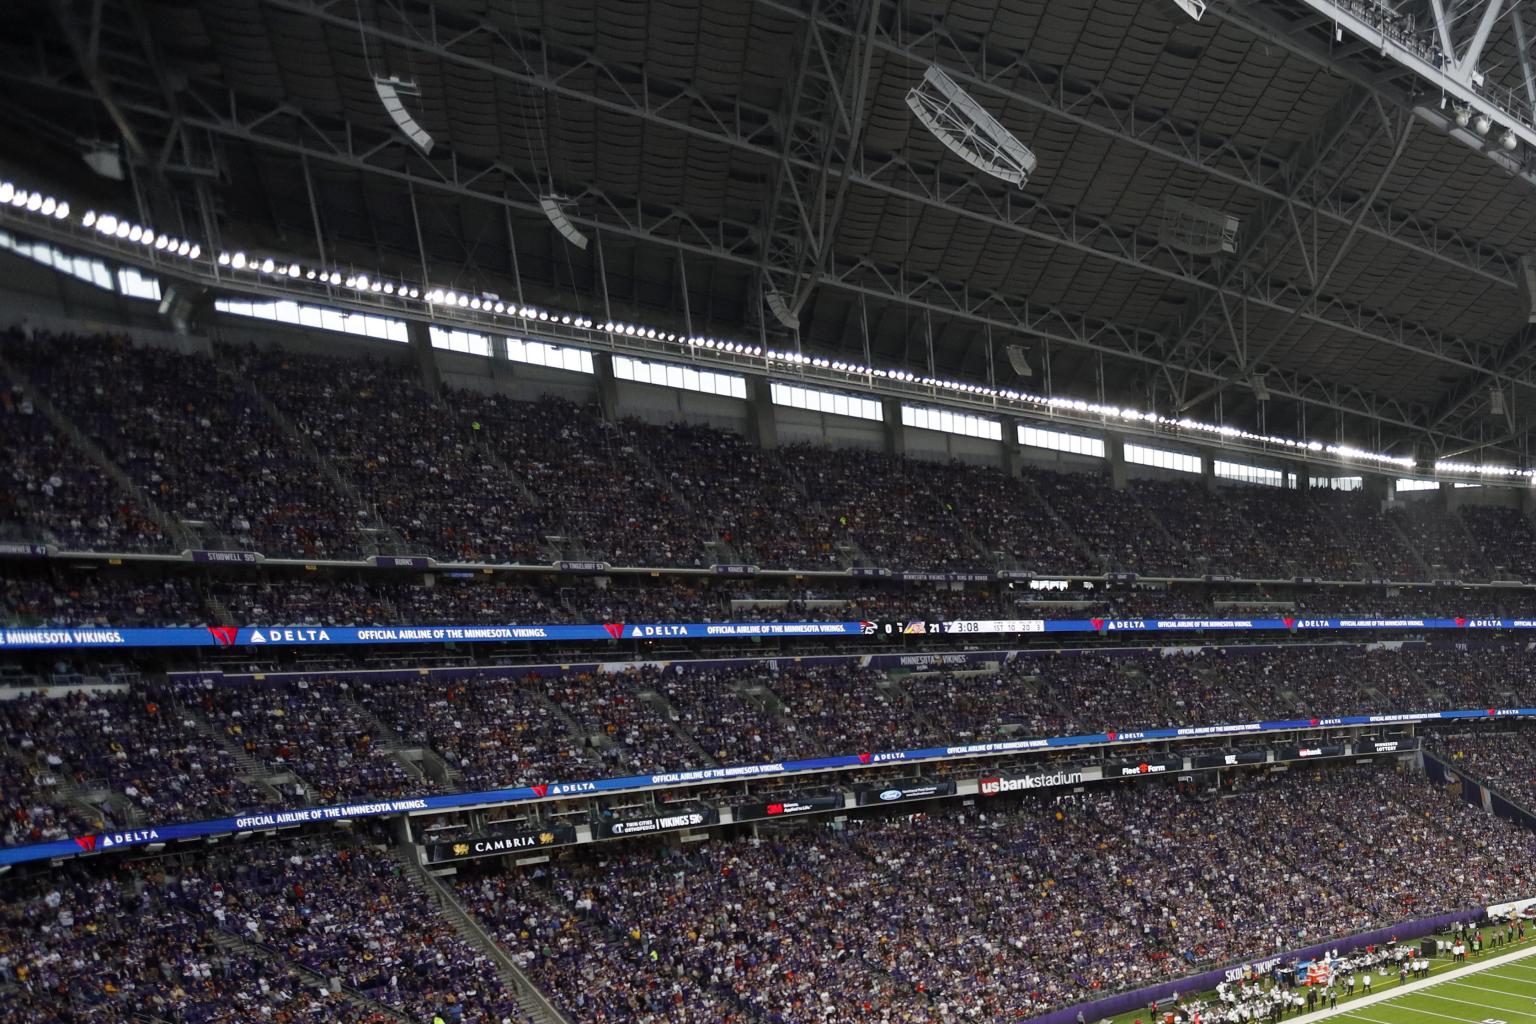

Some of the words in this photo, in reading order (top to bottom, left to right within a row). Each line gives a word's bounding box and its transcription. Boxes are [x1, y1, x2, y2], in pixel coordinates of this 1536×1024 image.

[646, 627, 687, 635] DELTA
[707, 626, 736, 634] OFFICIAL
[885, 623, 892, 634] 0
[929, 623, 940, 633] 21
[957, 622, 979, 632] 3:08
[7, 631, 73, 644] MINNESOTA
[73, 631, 125, 643] VIKINGS.
[271, 631, 330, 641] DELTA
[358, 631, 397, 639] OFFICIAL
[399, 630, 432, 638] AIRLINE
[433, 630, 444, 638] OF
[447, 630, 463, 638] THE
[464, 629, 512, 637] MINNESOTA
[900, 655, 935, 666] MINNESOTA
[942, 654, 967, 665] VIKINGS
[881, 752, 905, 760] DELTA
[1122, 767, 1140, 776] Fleet
[1147, 764, 1166, 773] Farm
[562, 782, 595, 792] DELTA
[767, 804, 784, 815] 3M
[236, 815, 275, 828] OFFICIAL
[278, 811, 310, 823] AIRLINE
[312, 810, 322, 820] OF
[324, 808, 341, 818] THE
[342, 803, 391, 817] MINNESOTA
[660, 816, 690, 829] VIKINGS
[115, 830, 158, 843] DELTA
[475, 837, 535, 853] CAMBRIA
[1225, 967, 1244, 983] SKOL
